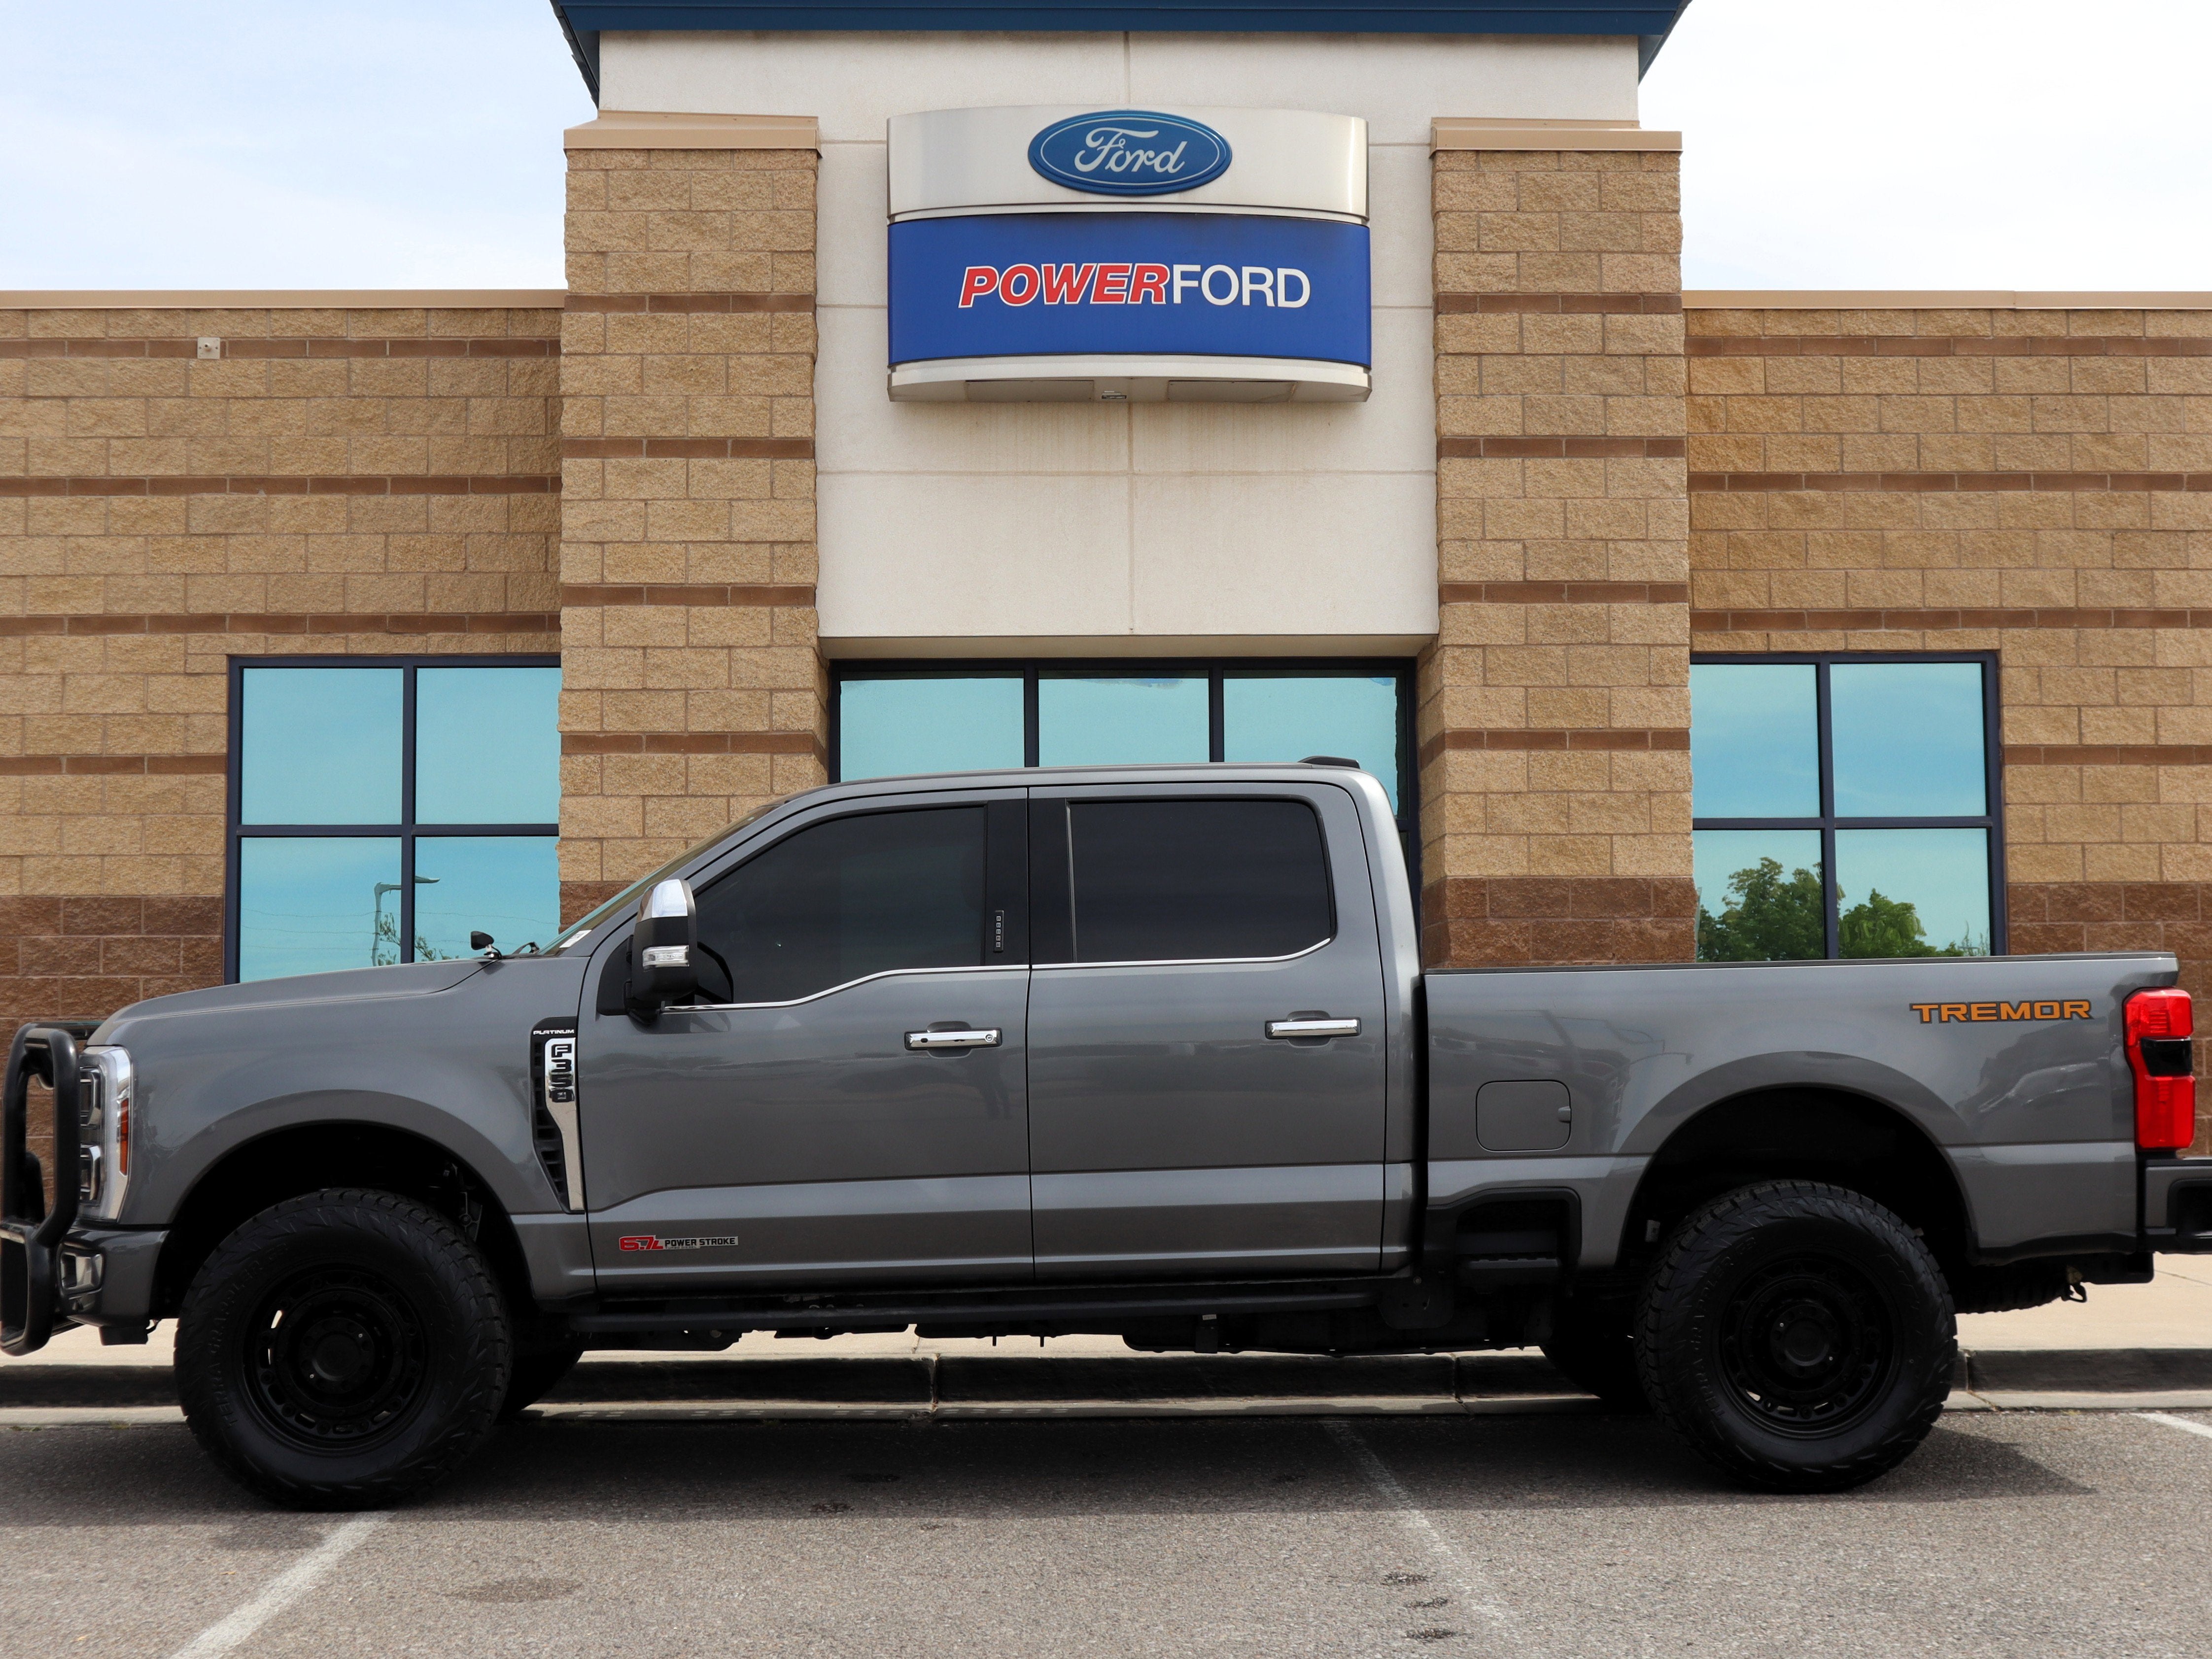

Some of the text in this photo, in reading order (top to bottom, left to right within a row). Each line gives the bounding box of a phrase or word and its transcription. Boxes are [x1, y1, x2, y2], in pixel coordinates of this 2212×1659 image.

[1073, 126, 1188, 174] Ford
[1910, 999, 2093, 1023] TREMOR
[620, 1236, 663, 1251] 6.7L
[665, 1239, 697, 1247] POWER
[699, 1237, 736, 1246] STROKE
